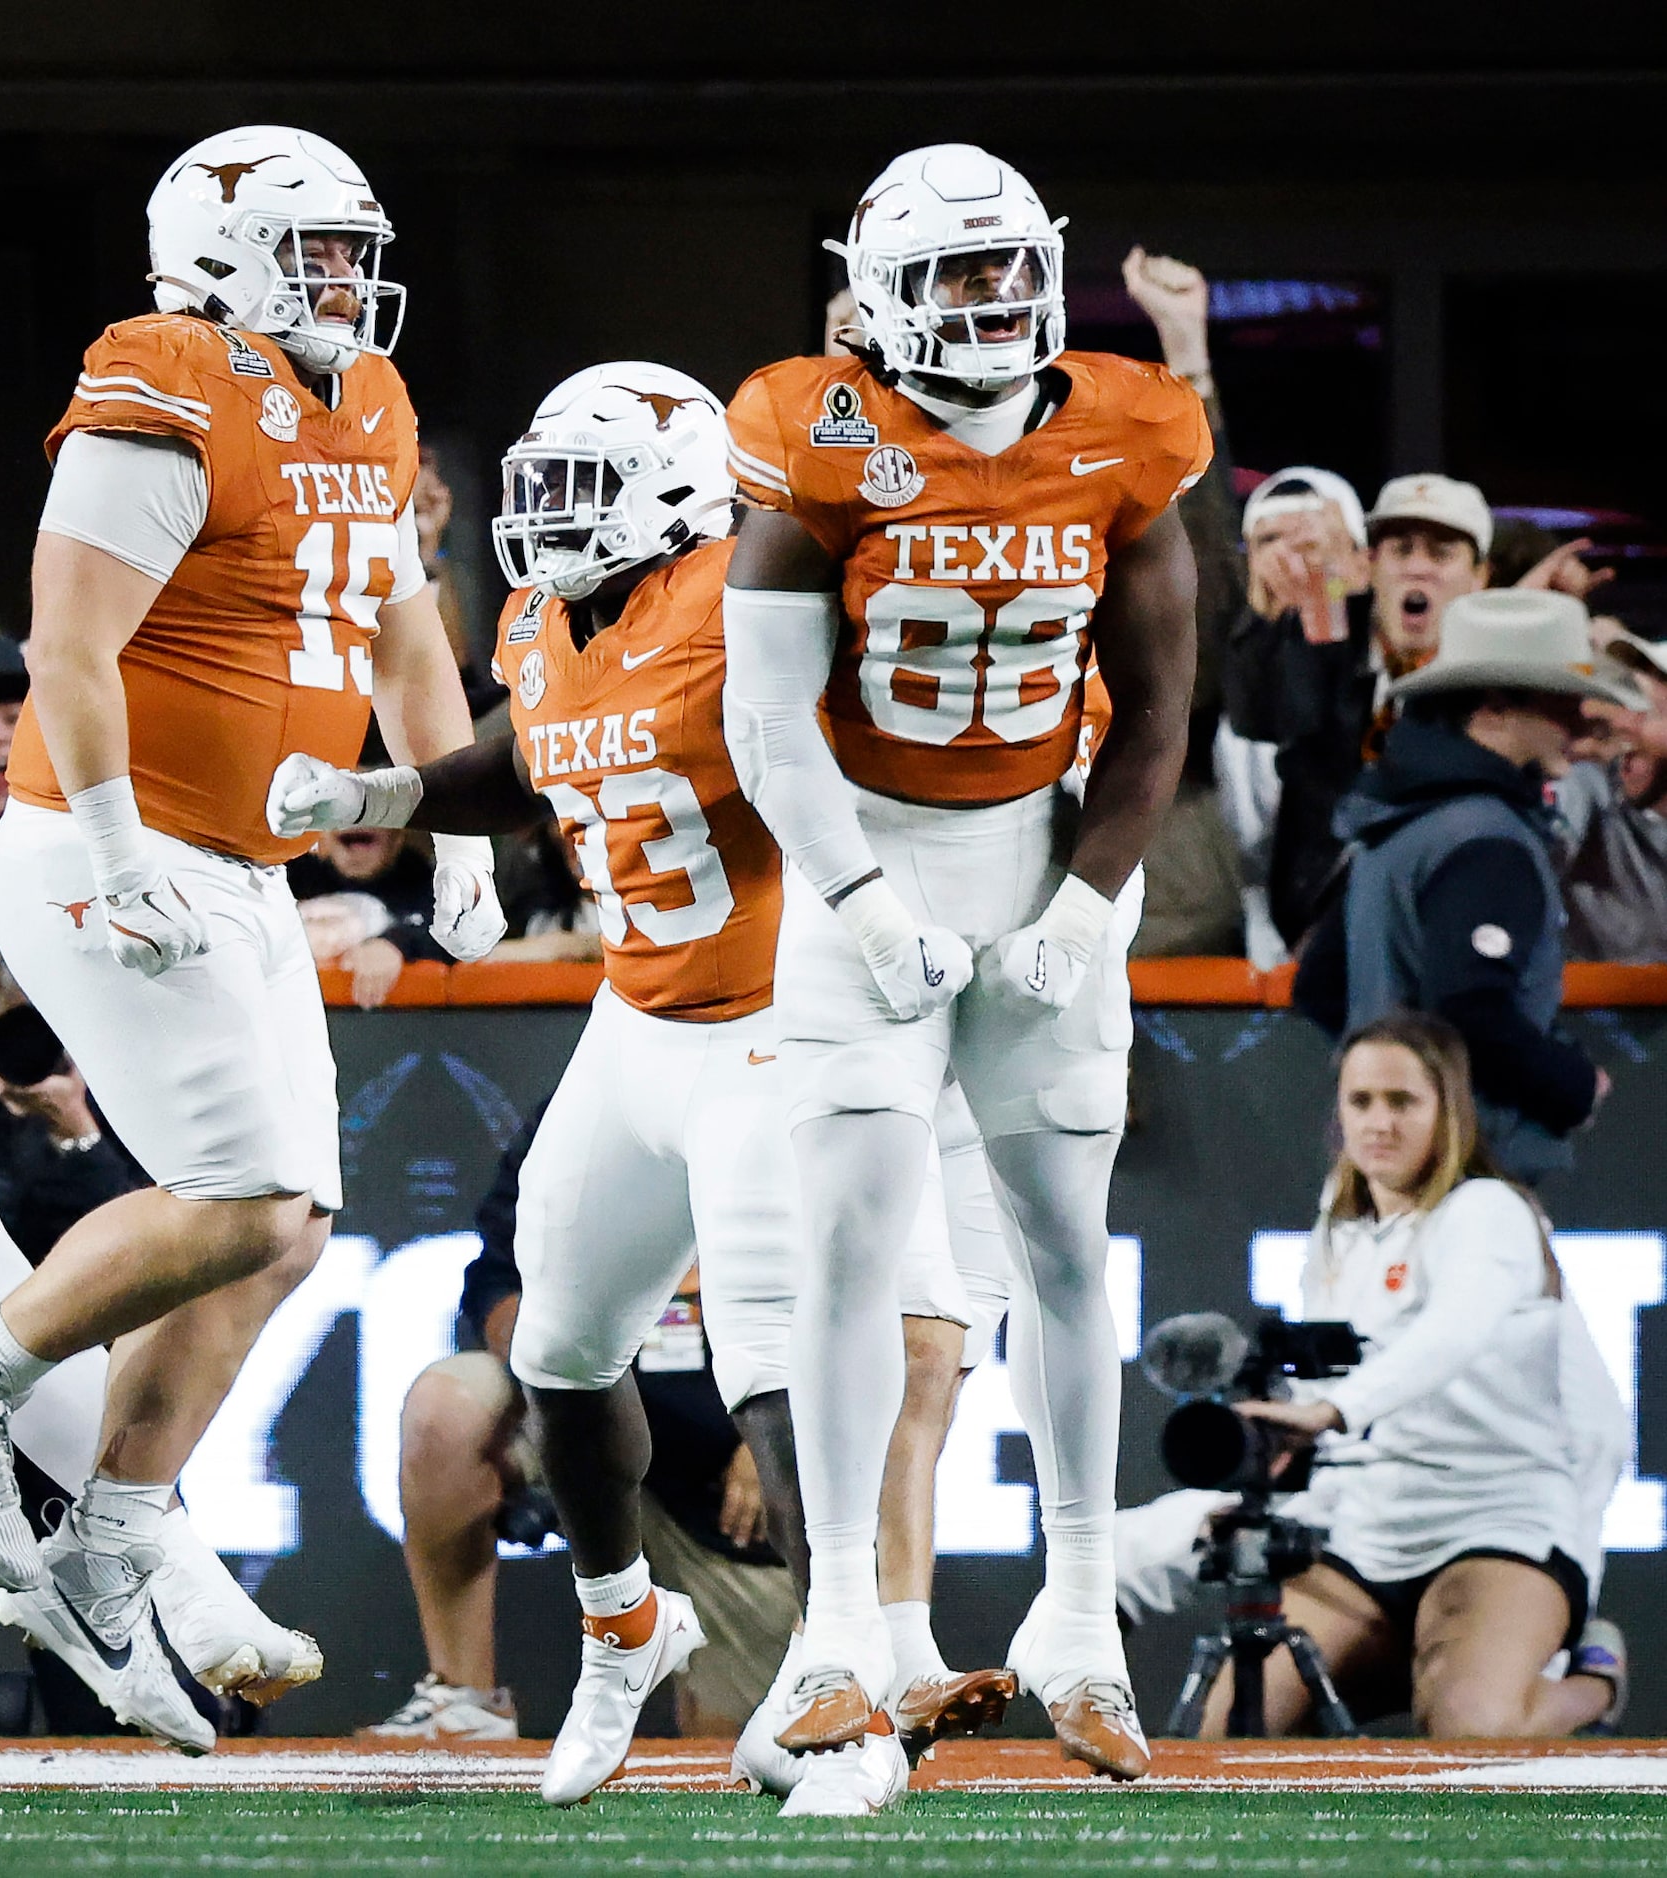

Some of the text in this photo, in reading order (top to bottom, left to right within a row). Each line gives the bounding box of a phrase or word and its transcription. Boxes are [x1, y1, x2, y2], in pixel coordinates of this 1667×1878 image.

[280, 462, 398, 516] TEXAS
[869, 448, 914, 493] SEC
[885, 524, 1092, 581] TEXAS
[858, 582, 1097, 746] 88
[528, 707, 658, 779] TEXAS
